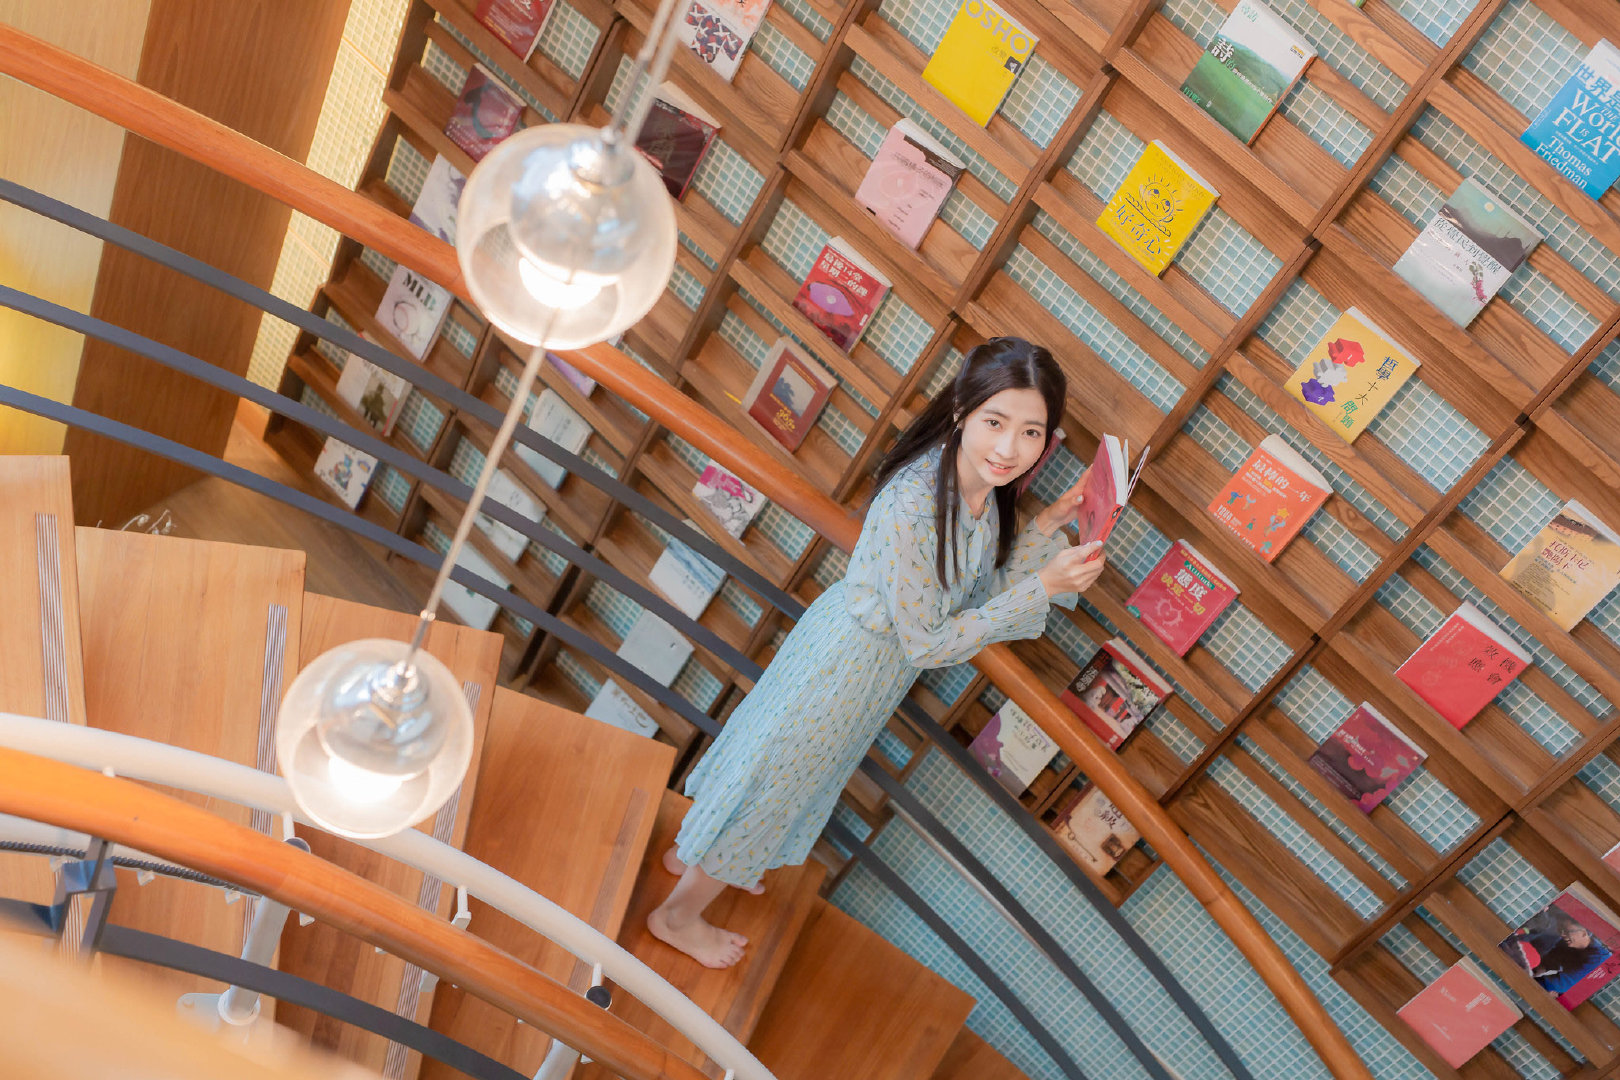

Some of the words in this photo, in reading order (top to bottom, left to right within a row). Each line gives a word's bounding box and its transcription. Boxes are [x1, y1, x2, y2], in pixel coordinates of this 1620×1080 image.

[965, 0, 1030, 54] OSHO
[1552, 107, 1620, 164] FLAT
[1580, 127, 1591, 138] IS
[1600, 105, 1619, 122] THE
[1535, 141, 1588, 190] Friedman
[1548, 135, 1593, 177] Thomas
[1113, 204, 1160, 254] 好奇心
[1340, 356, 1399, 429] 哲學十大問題
[1159, 572, 1206, 615] 決定一切
[1173, 568, 1208, 601] 態度
